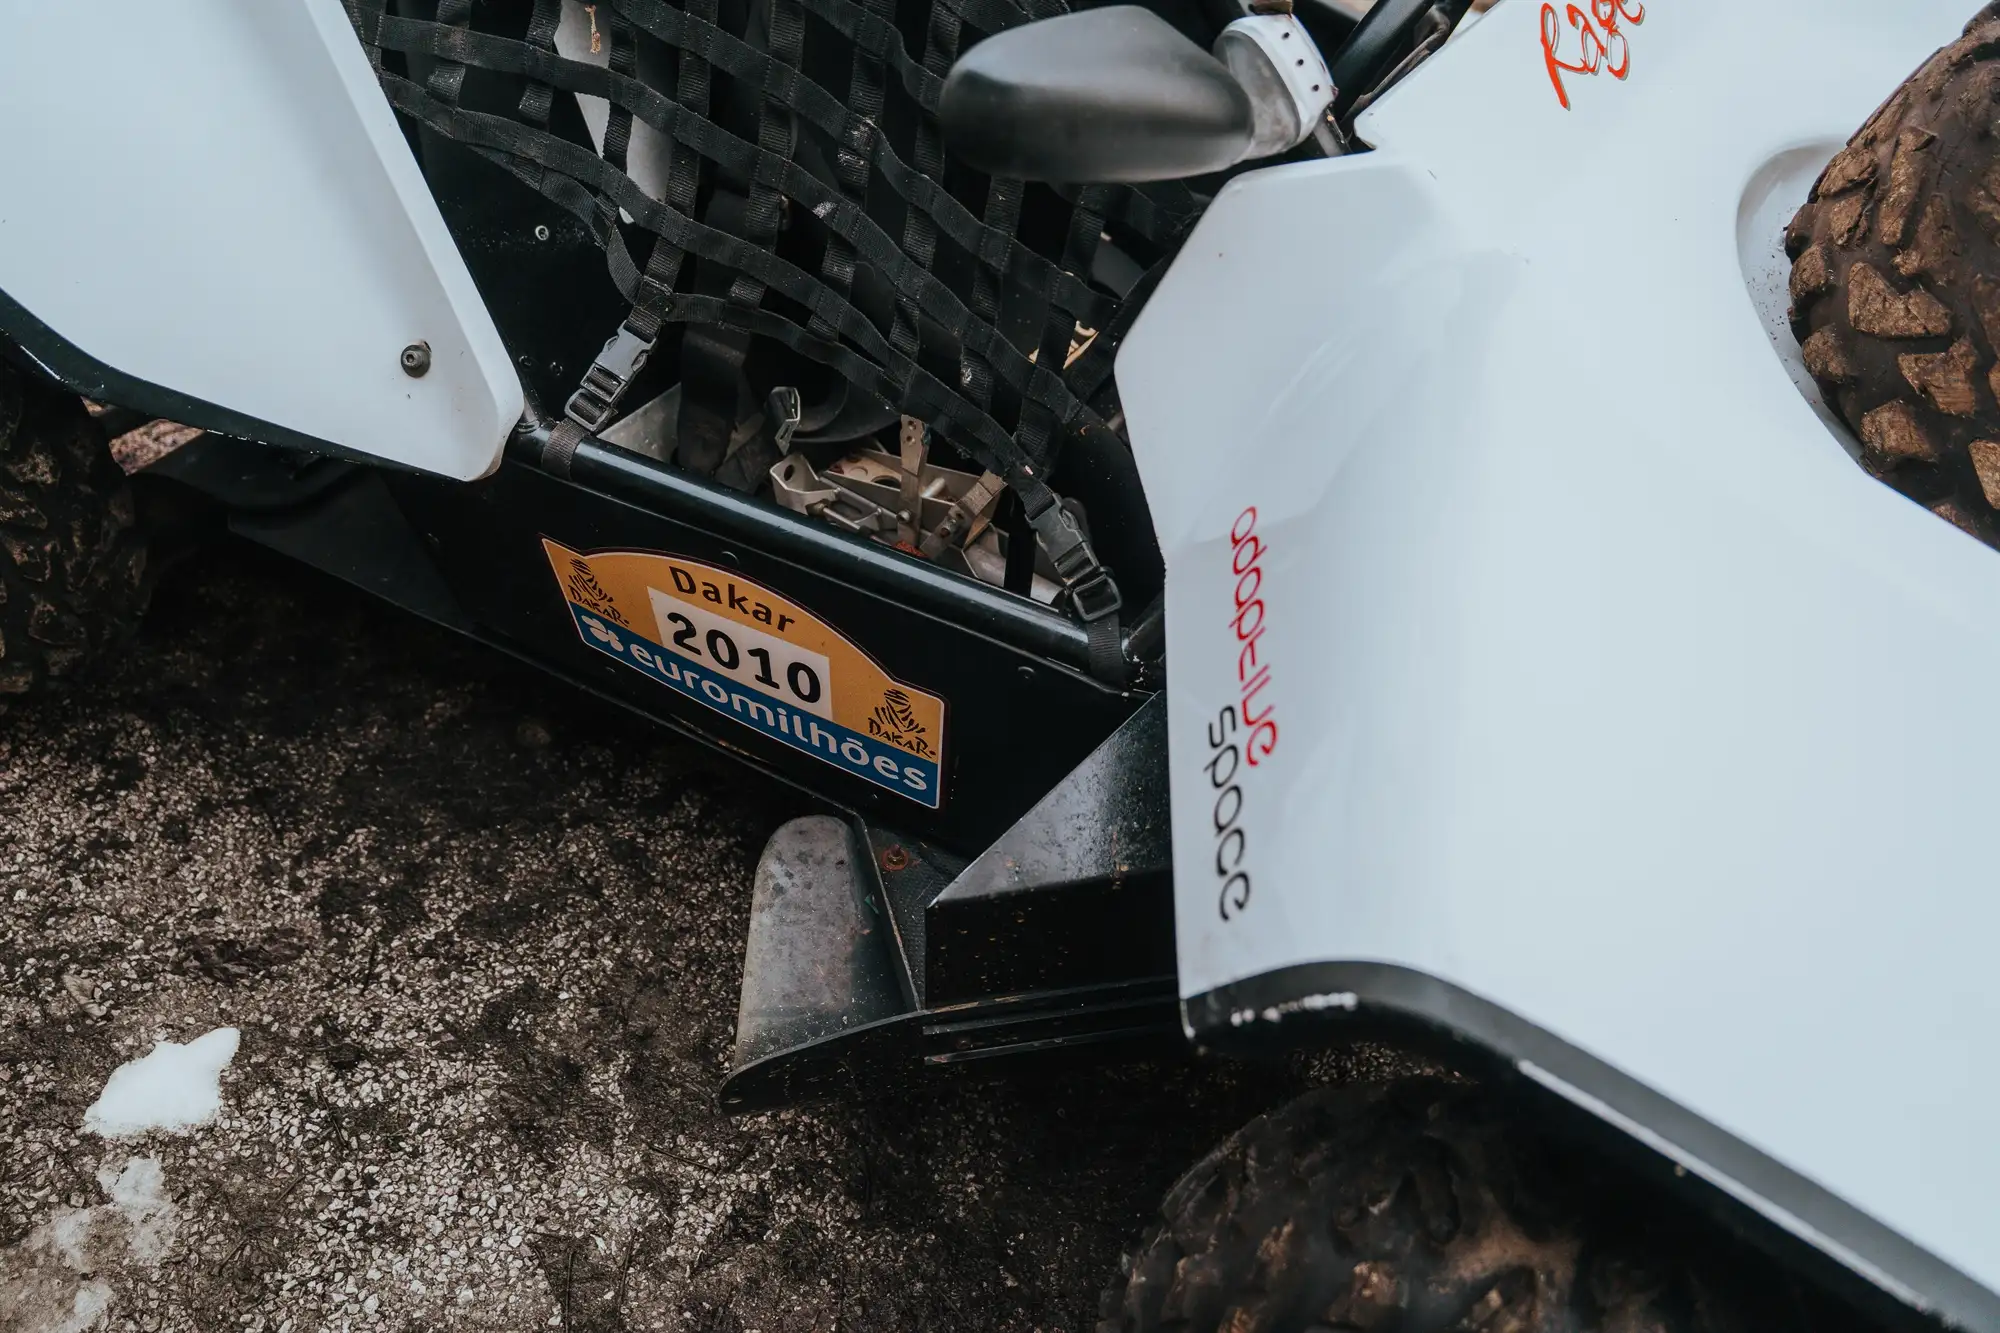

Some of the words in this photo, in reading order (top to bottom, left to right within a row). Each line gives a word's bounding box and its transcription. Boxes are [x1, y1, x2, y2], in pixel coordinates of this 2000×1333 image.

[666, 611, 822, 704] 2010
[668, 565, 796, 634] Dakar
[1229, 506, 1278, 767] adaptive
[629, 643, 928, 792] euromilhões
[867, 717, 937, 759] DAKAR
[1203, 706, 1250, 922] space
